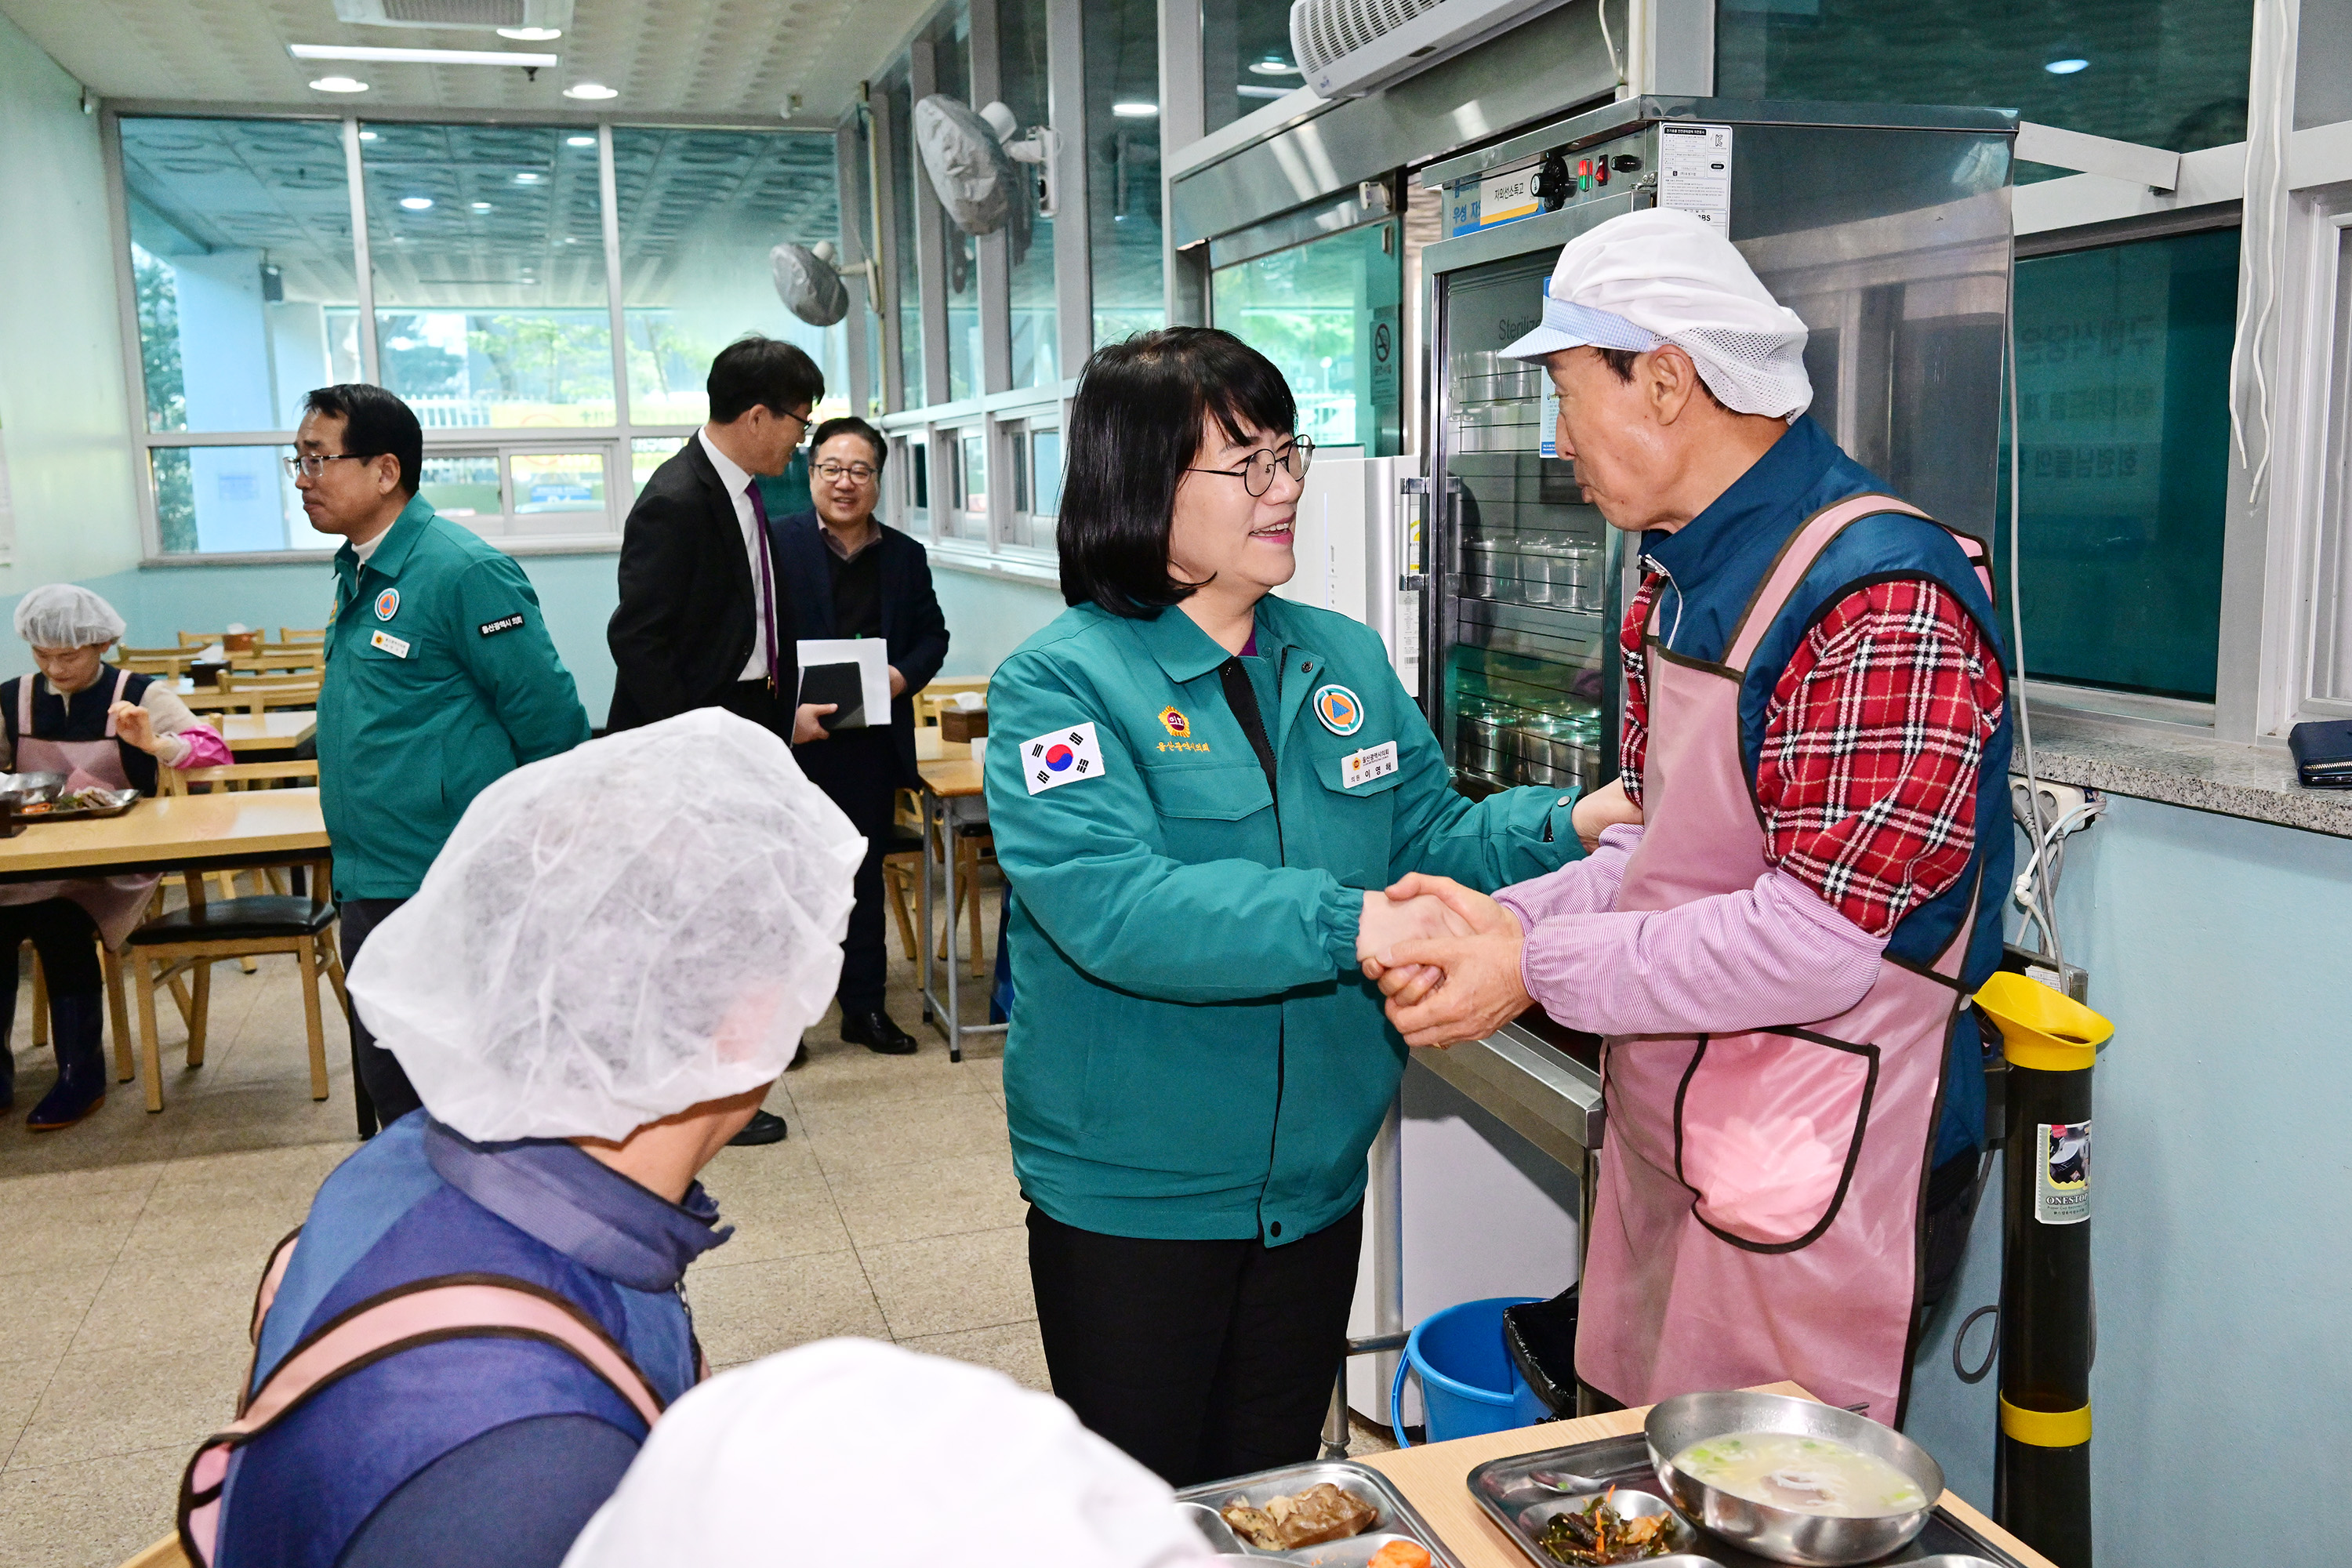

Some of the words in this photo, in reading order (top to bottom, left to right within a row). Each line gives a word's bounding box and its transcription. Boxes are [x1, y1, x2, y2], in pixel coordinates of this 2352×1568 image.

[1494, 183, 1524, 201] 자외선소독고
[1453, 204, 1467, 223] 우성
[481, 619, 512, 634] 울산광역시
[1156, 740, 1211, 753] 울산광역시의회
[1363, 749, 1389, 764] 울산광역시의회
[2045, 1192, 2088, 1205] ONESTOP
